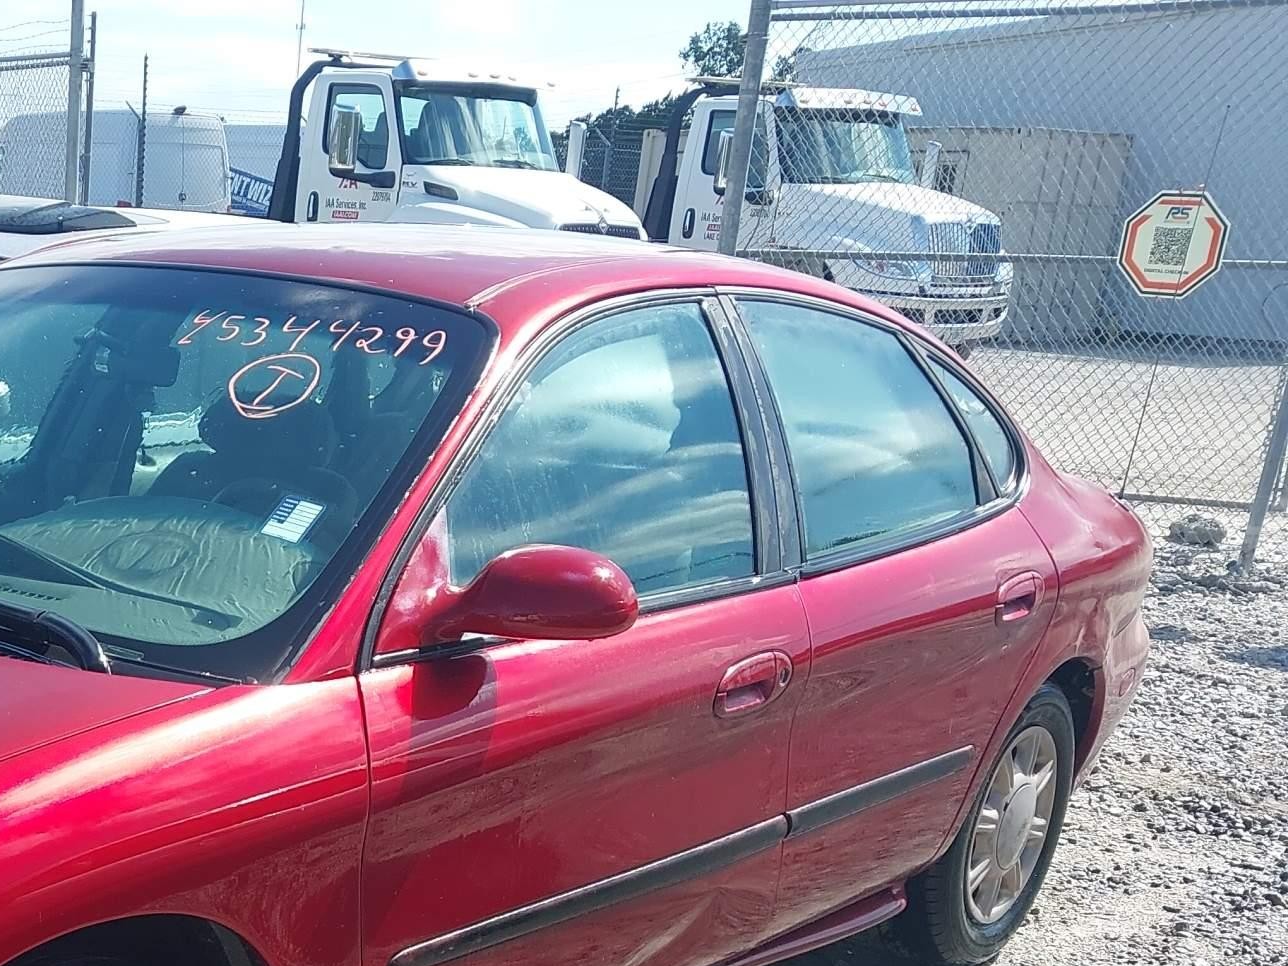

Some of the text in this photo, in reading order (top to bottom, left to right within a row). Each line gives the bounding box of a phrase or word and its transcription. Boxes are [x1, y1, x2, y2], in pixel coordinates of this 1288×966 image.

[325, 197, 335, 208] IAA
[701, 212, 711, 222] IAA
[177, 309, 448, 366] 45344299
